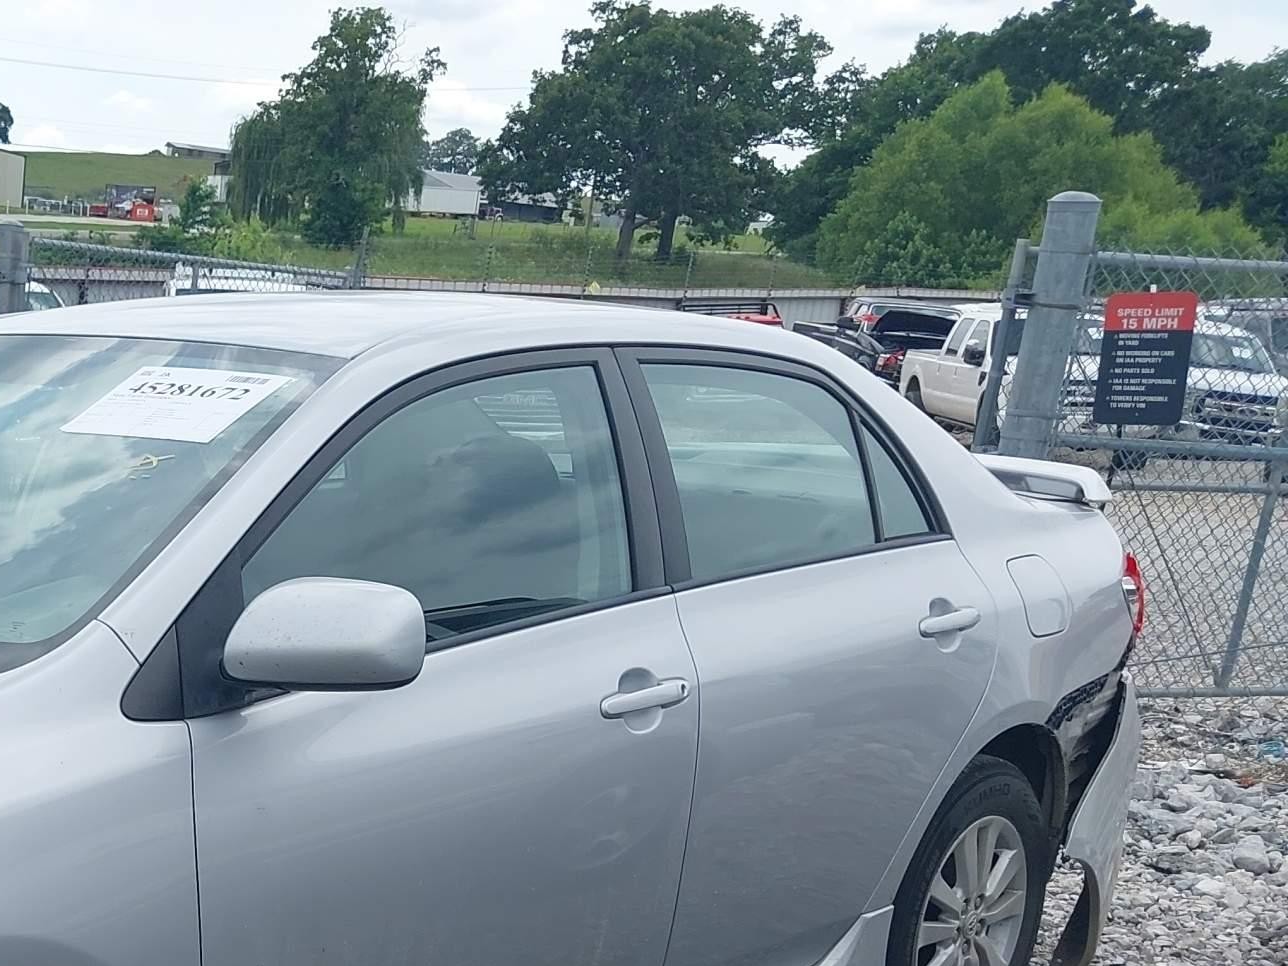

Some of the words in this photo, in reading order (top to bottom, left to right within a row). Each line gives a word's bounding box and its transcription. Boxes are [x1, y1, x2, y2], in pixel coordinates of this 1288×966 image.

[1117, 308, 1152, 317] SPEED
[1155, 307, 1185, 316] LIMIT
[1121, 318, 1138, 329] 15
[1142, 317, 1179, 329] MPH
[129, 381, 251, 400] 45281672
